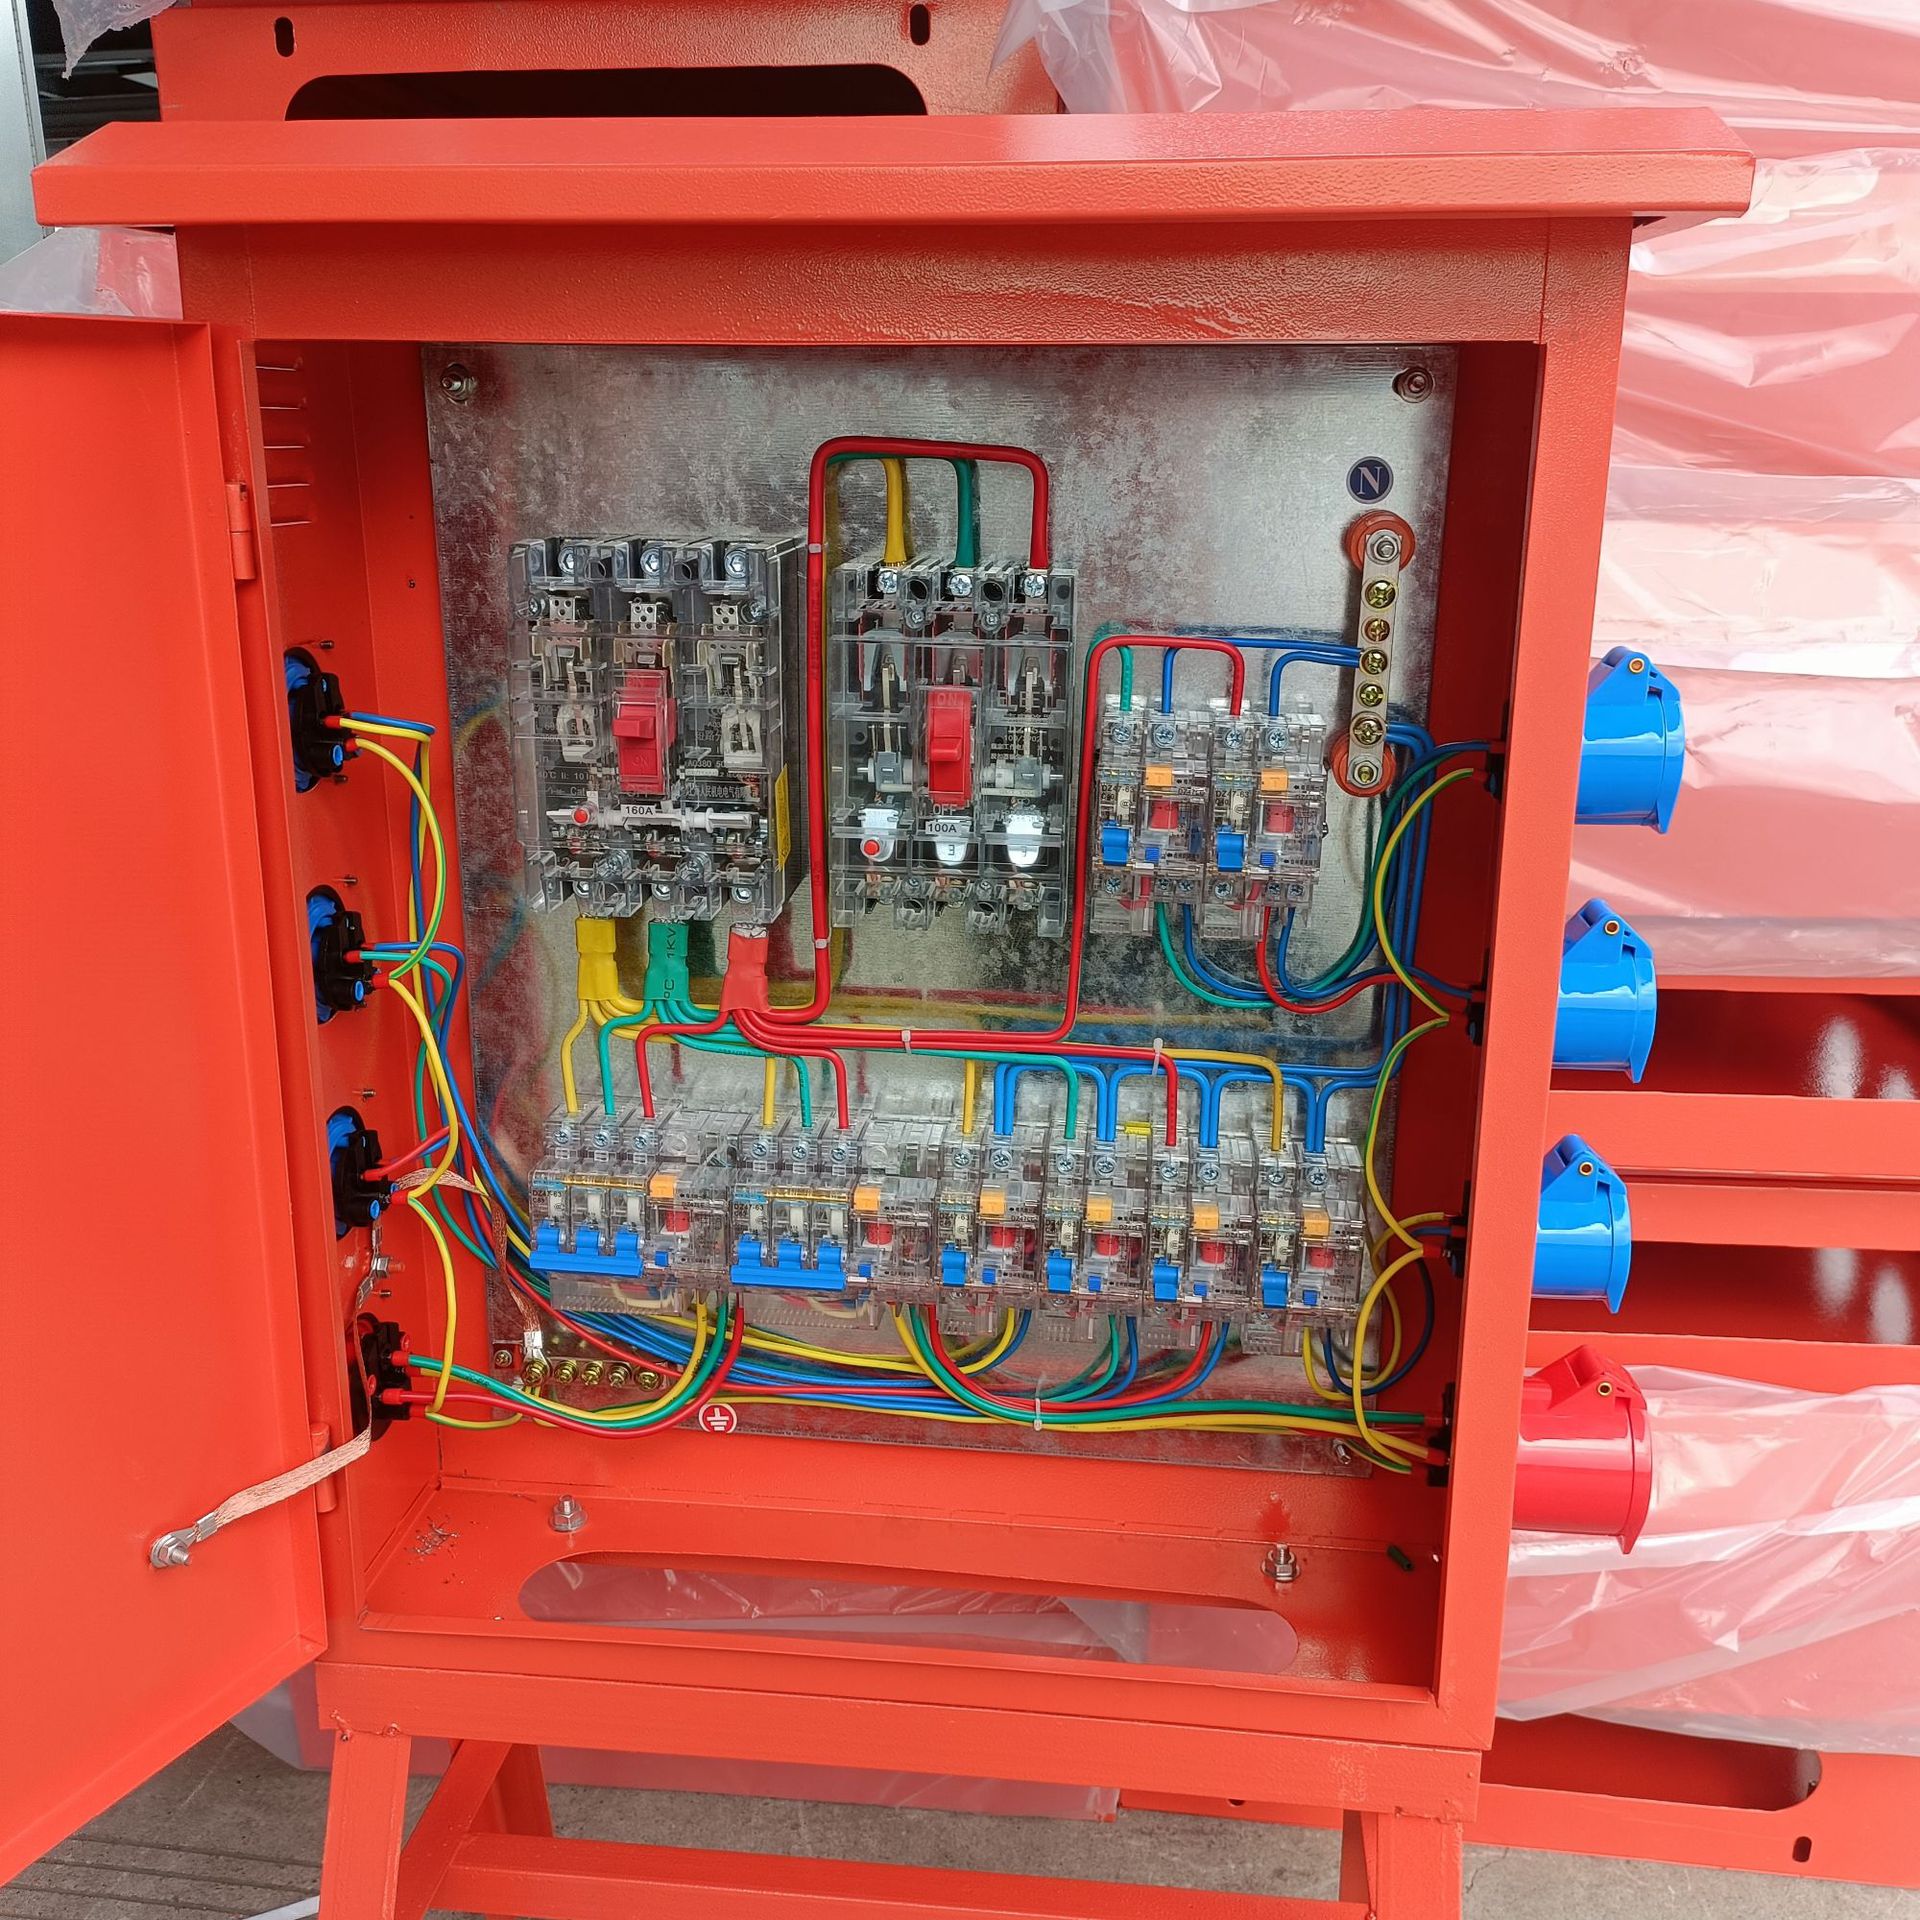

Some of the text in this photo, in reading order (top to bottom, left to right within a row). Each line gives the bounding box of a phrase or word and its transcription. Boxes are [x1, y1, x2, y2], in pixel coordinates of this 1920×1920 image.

[1356, 465, 1384, 496] N
[625, 805, 654, 816] 160A
[927, 823, 958, 834] 100A
[666, 927, 677, 959] 1KV
